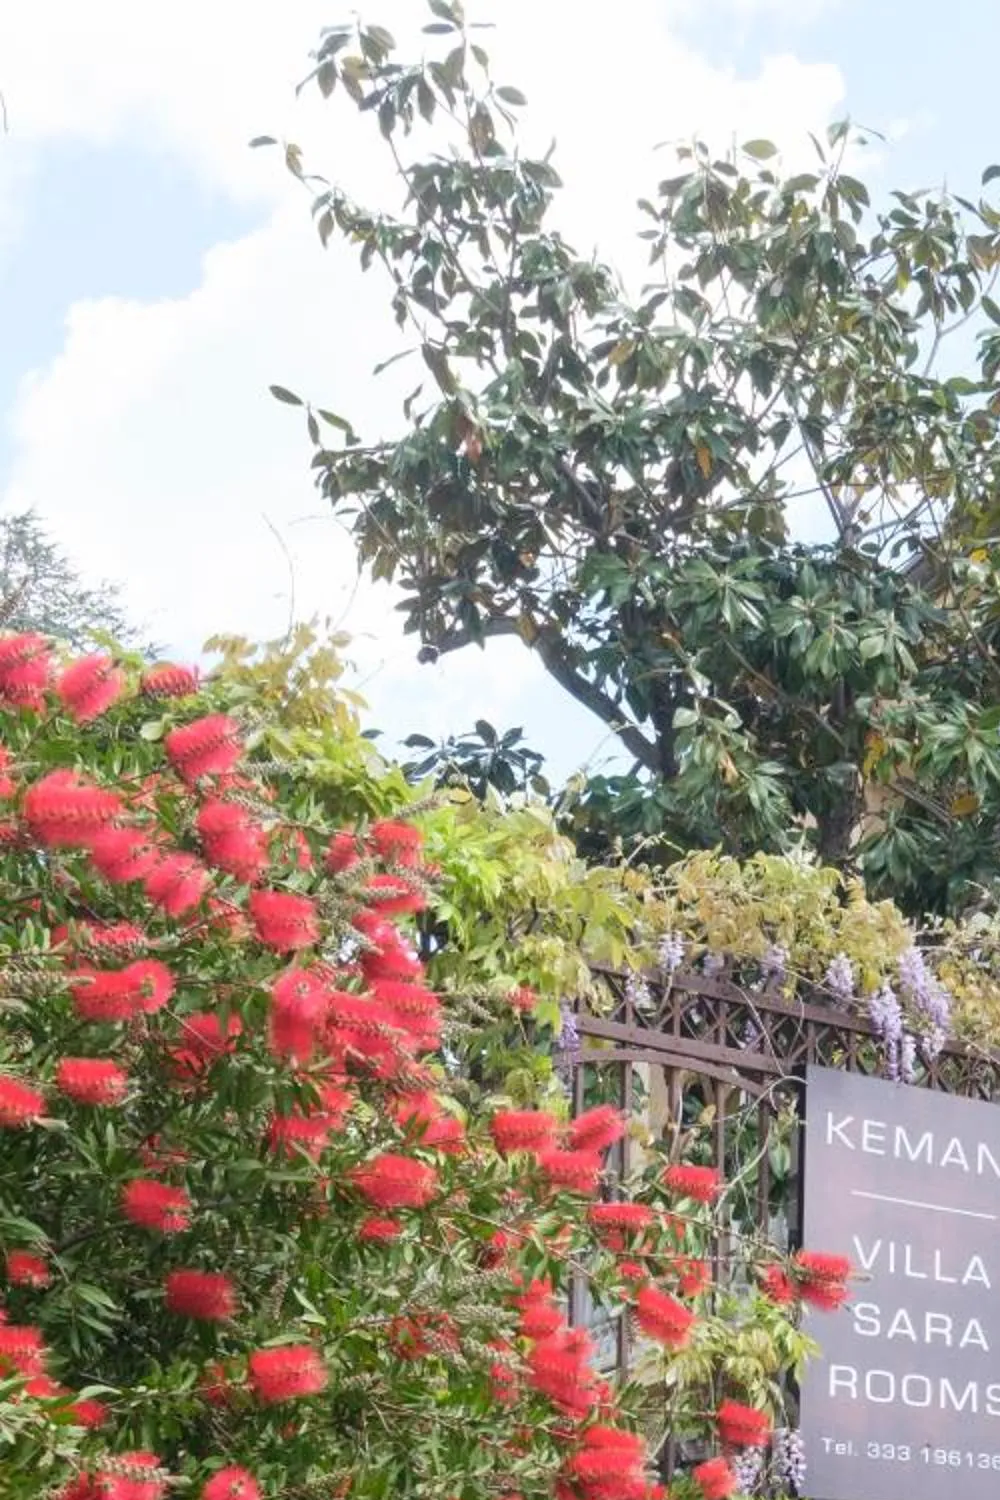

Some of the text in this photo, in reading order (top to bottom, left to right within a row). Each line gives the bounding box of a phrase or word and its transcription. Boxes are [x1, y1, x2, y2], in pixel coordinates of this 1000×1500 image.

[853, 1235, 991, 1288] VILLA
[853, 1303, 989, 1352] SARA
[821, 1437, 858, 1457] Tel.
[867, 1441, 911, 1461] 333
